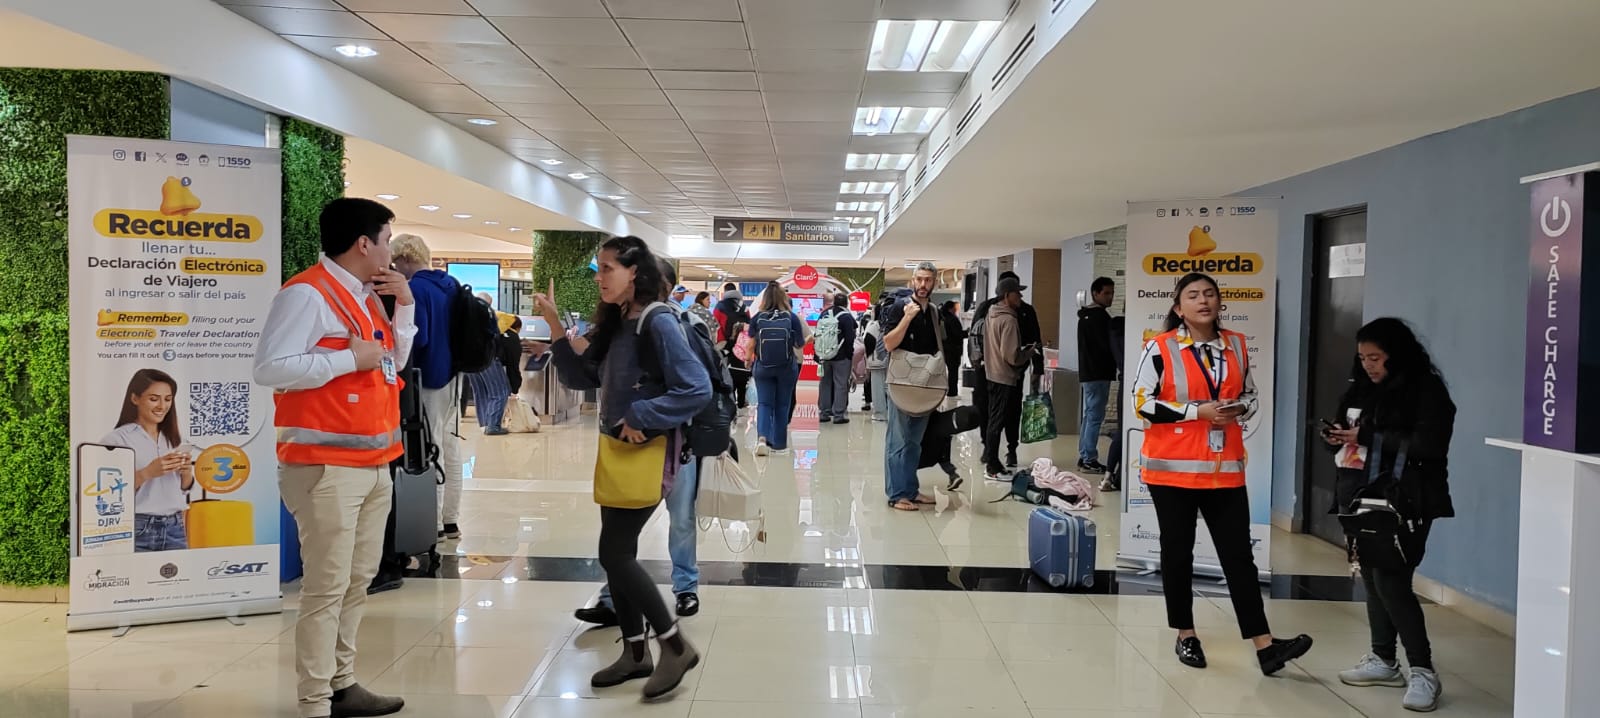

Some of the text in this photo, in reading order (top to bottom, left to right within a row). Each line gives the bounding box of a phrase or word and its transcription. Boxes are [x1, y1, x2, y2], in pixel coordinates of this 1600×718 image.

[228, 157, 251, 166] 1550
[109, 213, 250, 239] Recuerda
[785, 222, 827, 231] Restrooms
[785, 231, 834, 241] Sanitarios
[142, 242, 216, 255] llenar tu...
[88, 257, 264, 273] Declaración Electrónica
[1152, 256, 1253, 272] Recuerda
[144, 275, 217, 288] de Viajero
[105, 288, 114, 297] al
[119, 288, 164, 299] ingresar
[179, 289, 200, 298] salir
[204, 290, 220, 299] del
[224, 290, 246, 301] país
[117, 314, 182, 322] Remember
[192, 316, 216, 324] filling
[235, 317, 255, 325] your
[160, 330, 200, 338] Traveler
[202, 330, 260, 338] Declaration
[1542, 246, 1560, 435] SAFE CHARGE
[213, 457, 233, 482] 3
[98, 518, 120, 527] DJRV
[224, 562, 268, 574] SAT
